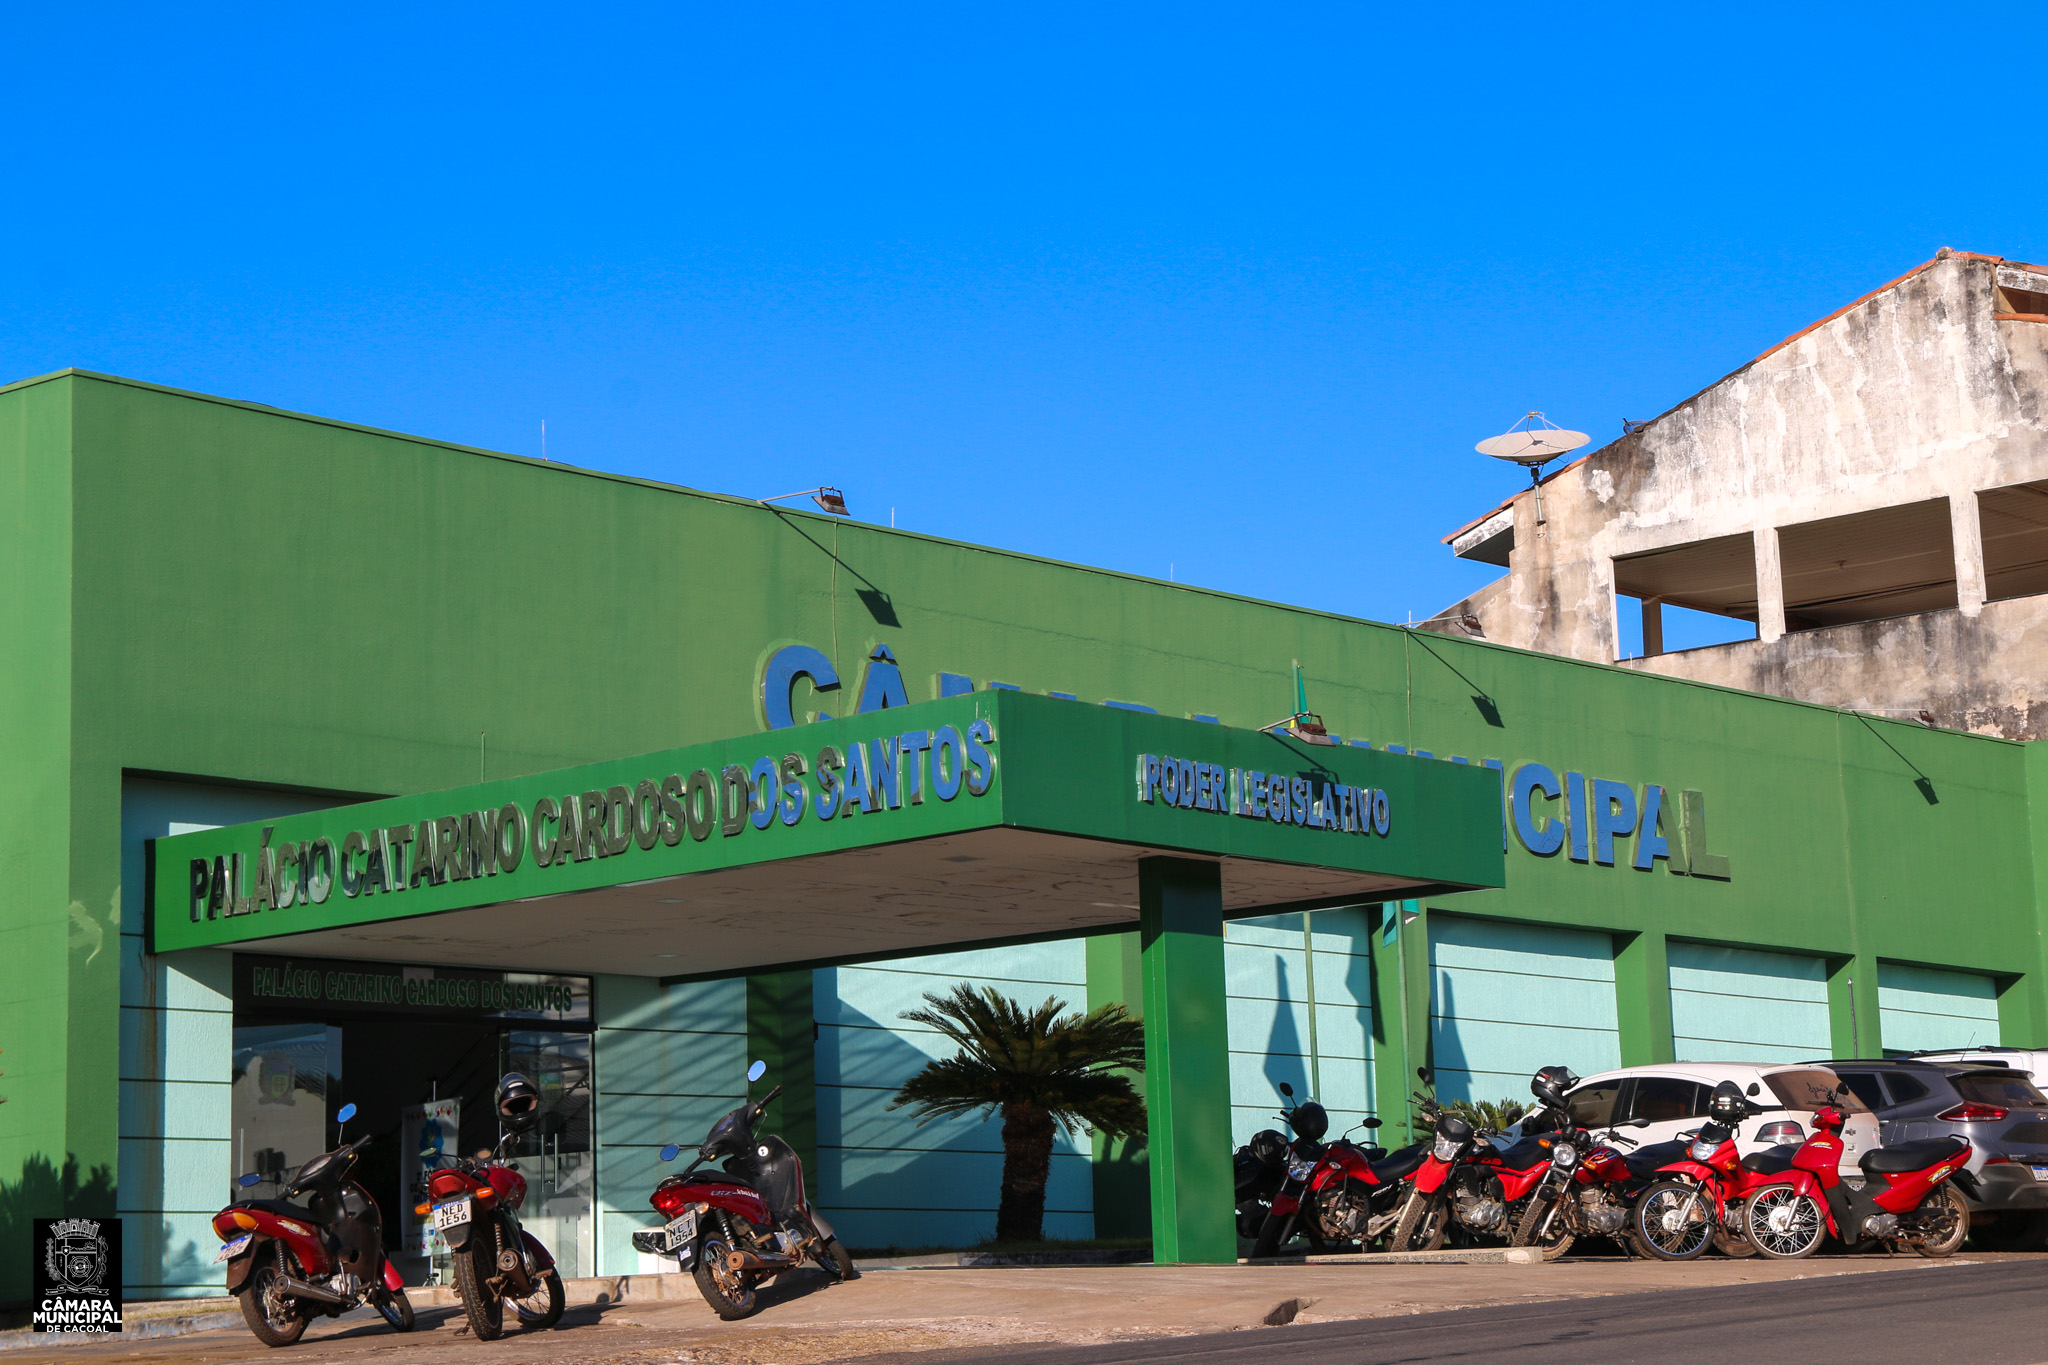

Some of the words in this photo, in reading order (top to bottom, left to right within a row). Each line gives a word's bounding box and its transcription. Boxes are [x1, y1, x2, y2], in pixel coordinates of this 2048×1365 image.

[1136, 753, 1229, 813] PODER
[1231, 767, 1391, 837] LEGISLATIVO
[189, 826, 335, 922] PALÁCIO
[341, 801, 527, 898] CATARINO
[531, 768, 717, 868] CARDOSO
[721, 752, 808, 837] DOS
[814, 719, 997, 821] SANTOS
[253, 962, 322, 999] PALÁCIO
[325, 971, 403, 1004] CATARINO
[406, 978, 478, 1008] CARDOSO
[482, 981, 512, 1009] DOS
[515, 982, 573, 1012] SANTOS
[439, 1211, 467, 1228] 1E56
[442, 1203, 463, 1217] NED
[670, 1219, 692, 1239] NCT
[671, 1229, 693, 1247] 1954
